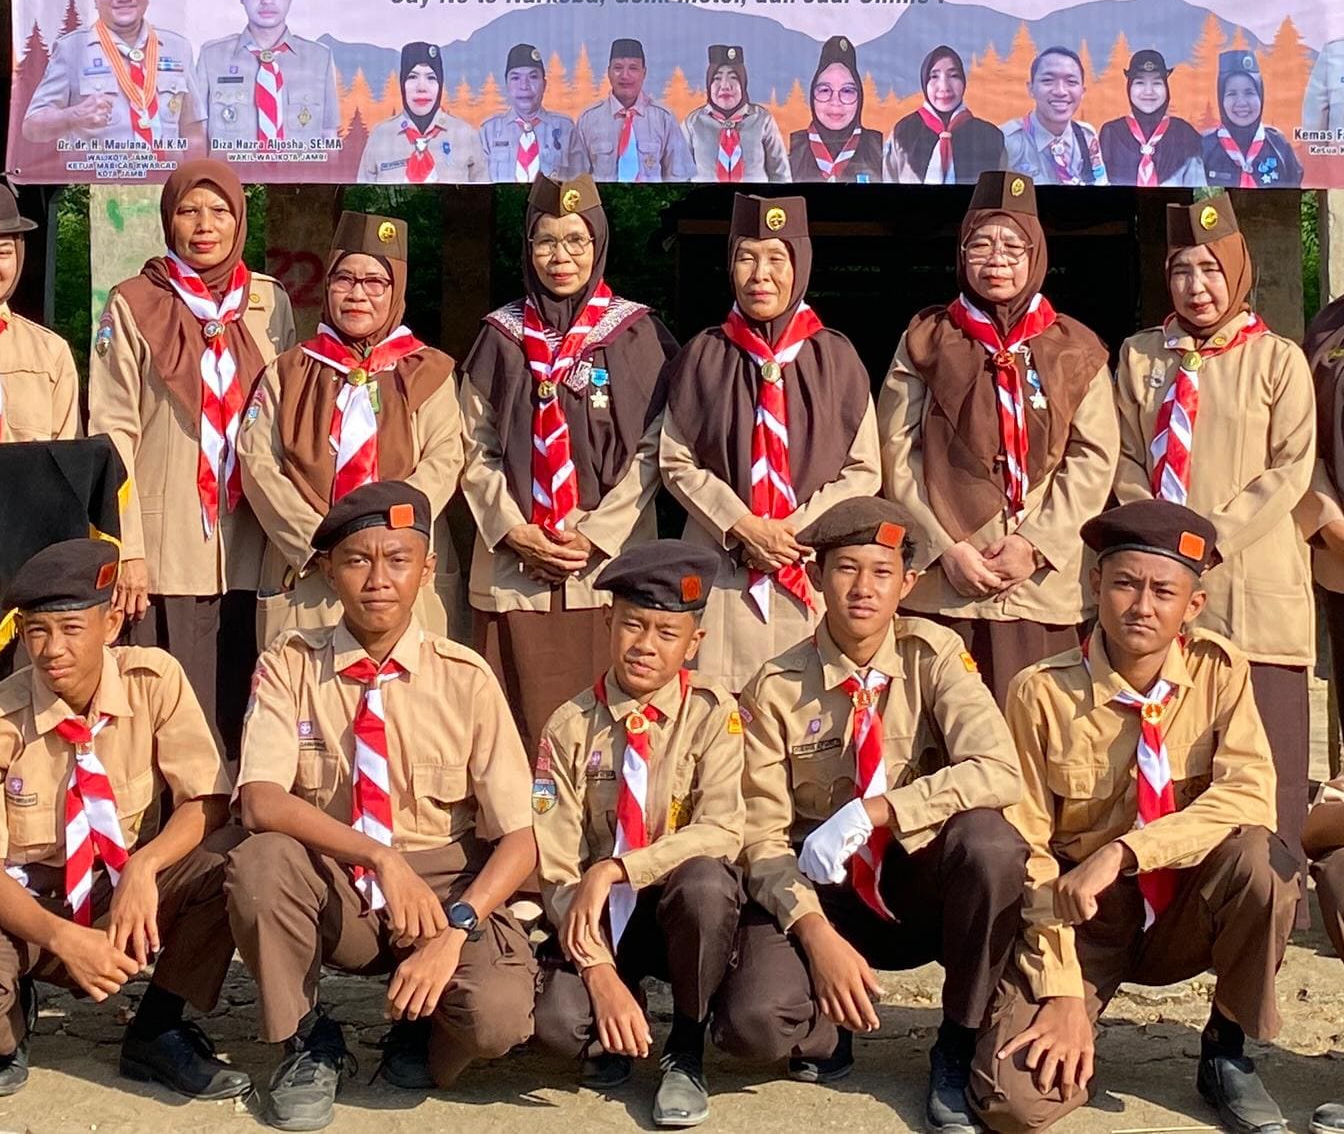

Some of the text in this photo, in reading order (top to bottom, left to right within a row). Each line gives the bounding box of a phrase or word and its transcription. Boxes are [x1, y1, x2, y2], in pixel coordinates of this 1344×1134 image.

[1294, 128, 1333, 141] Kemas
[104, 139, 151, 151] Maulana,
[212, 138, 233, 149] Diza
[236, 138, 264, 149] Hazra
[1310, 146, 1337, 155] Ketua
